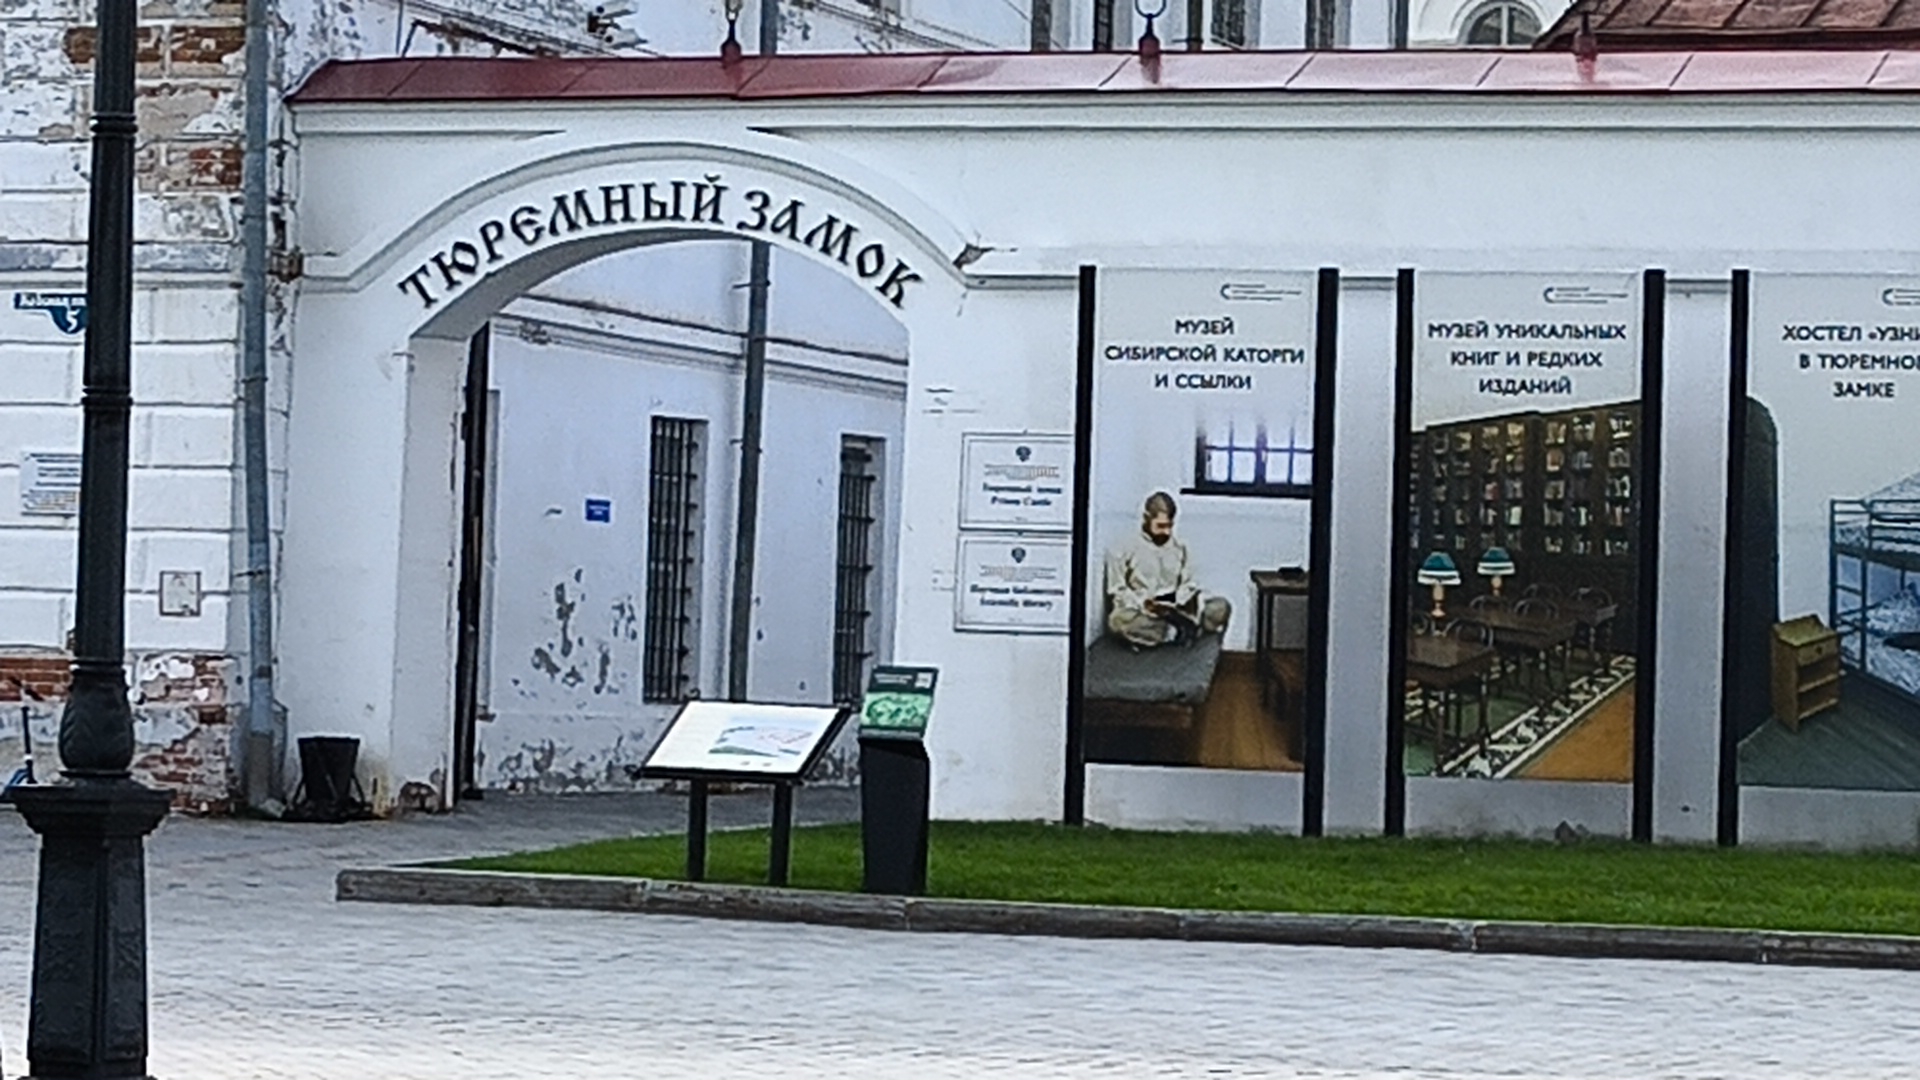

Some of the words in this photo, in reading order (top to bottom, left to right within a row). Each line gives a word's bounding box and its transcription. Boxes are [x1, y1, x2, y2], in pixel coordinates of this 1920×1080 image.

[397, 172, 728, 308] ТЮРЕМНЫЙ
[736, 190, 925, 308] ЗАМОК
[65, 307, 81, 332] 5
[1175, 316, 1234, 335] МУЗЕЙ
[1428, 320, 1489, 339] МУЗЕЙ
[1494, 323, 1627, 340] УНИКАЛЬНЫХ
[1782, 324, 1862, 342] ХОСТЕЛ
[1104, 344, 1217, 362] СИБИРСКОЙ
[1223, 347, 1305, 364] КАТОРГИ
[1450, 351, 1501, 367] КНИГ
[1506, 351, 1520, 366] И
[1527, 351, 1603, 369] РЕДКИХ
[1799, 353, 1811, 369] В
[1817, 353, 1920, 371] ТЮРЕМНО
[1155, 374, 1169, 388] И
[1175, 373, 1252, 390] ССЫЛКИ
[1479, 375, 1572, 396] ИЗДАНИЙ
[1833, 381, 1895, 398] ЗАМКЕ
